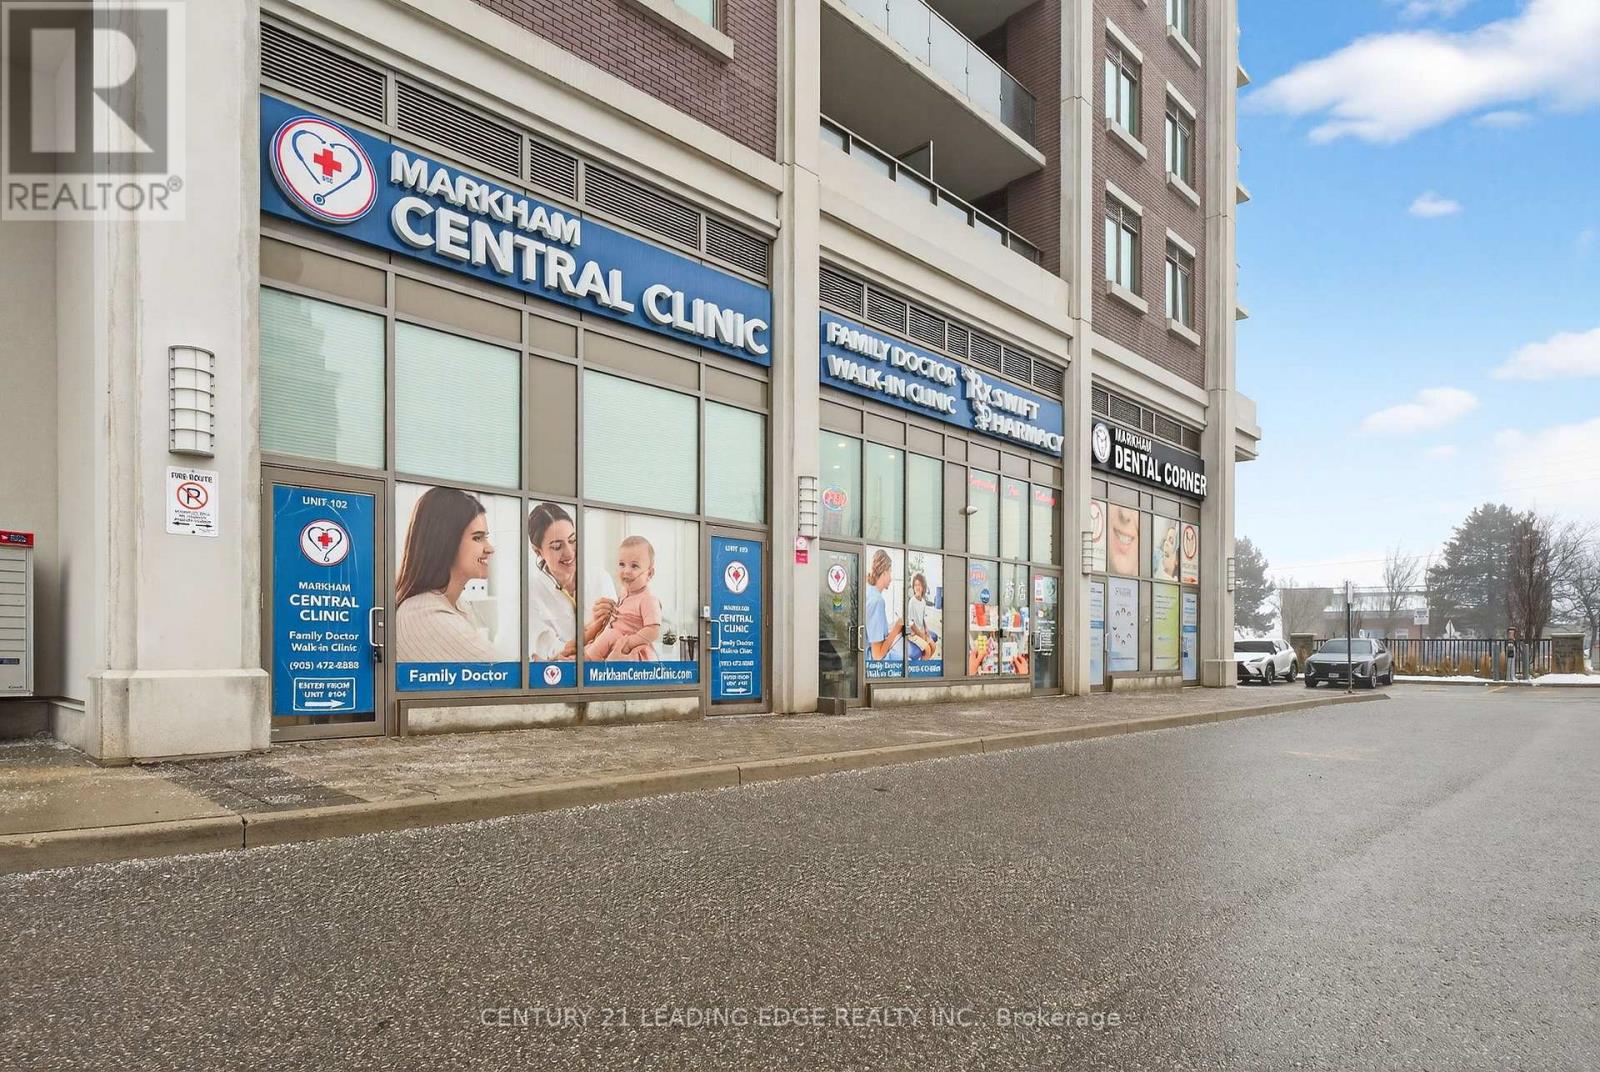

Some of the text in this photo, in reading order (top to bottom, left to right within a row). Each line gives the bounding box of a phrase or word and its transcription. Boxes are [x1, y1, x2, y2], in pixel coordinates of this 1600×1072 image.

[391, 150, 581, 247] MARKHAM
[391, 196, 769, 356] CENTRAL CLINIC
[827, 321, 957, 387] FAMILY DOCTOR
[827, 354, 957, 415] WALK-IN CLINIC
[991, 388, 1040, 421] SWIFT
[980, 405, 1064, 452] PHARMACY
[1115, 428, 1152, 453] MARKHAM
[1115, 445, 1207, 497] DENTAL CORNER
[303, 495, 348, 509] UNIT 102
[298, 581, 351, 592] MARKHAM
[289, 593, 360, 608] CENTRAL
[299, 609, 350, 622] CLINIC
[719, 613, 754, 623] CENTRAL
[289, 630, 360, 642] Family Doctor
[330, 643, 358, 652] Clinic
[409, 669, 508, 685] Family Doctor
[589, 667, 693, 681] MarkhamCentralClinic.com
